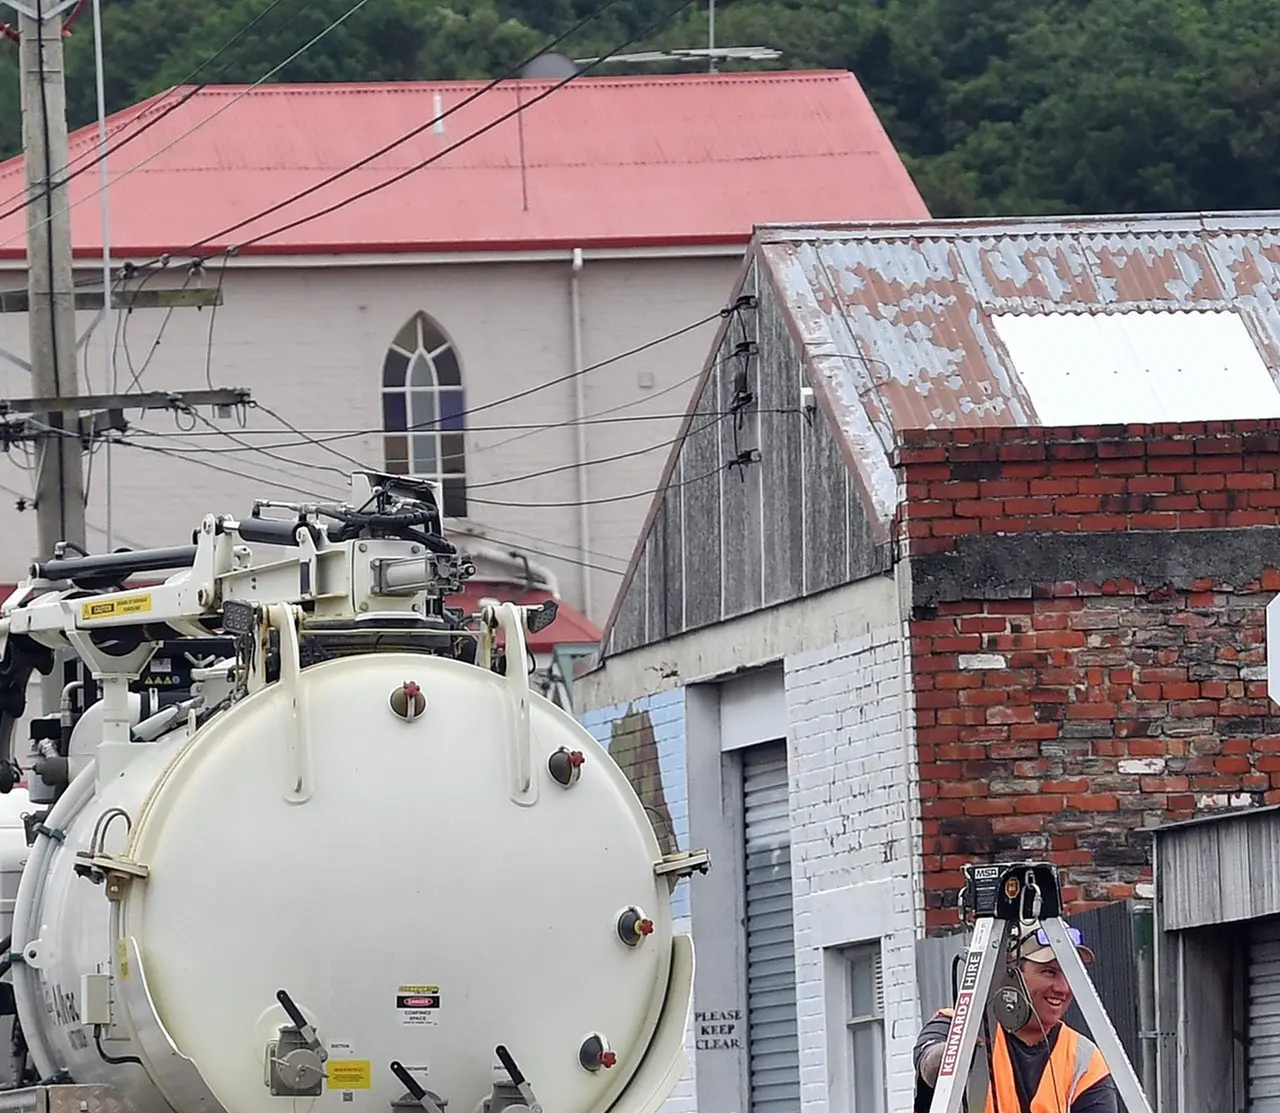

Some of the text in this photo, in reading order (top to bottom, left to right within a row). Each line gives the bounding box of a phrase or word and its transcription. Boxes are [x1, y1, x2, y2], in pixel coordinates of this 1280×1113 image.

[694, 1010, 742, 1021] PLEASE
[942, 996, 970, 1073] KENNARDS
[964, 954, 982, 987] HIRE
[701, 1024, 735, 1035] KEEP
[696, 1039, 740, 1050] CLEAR
